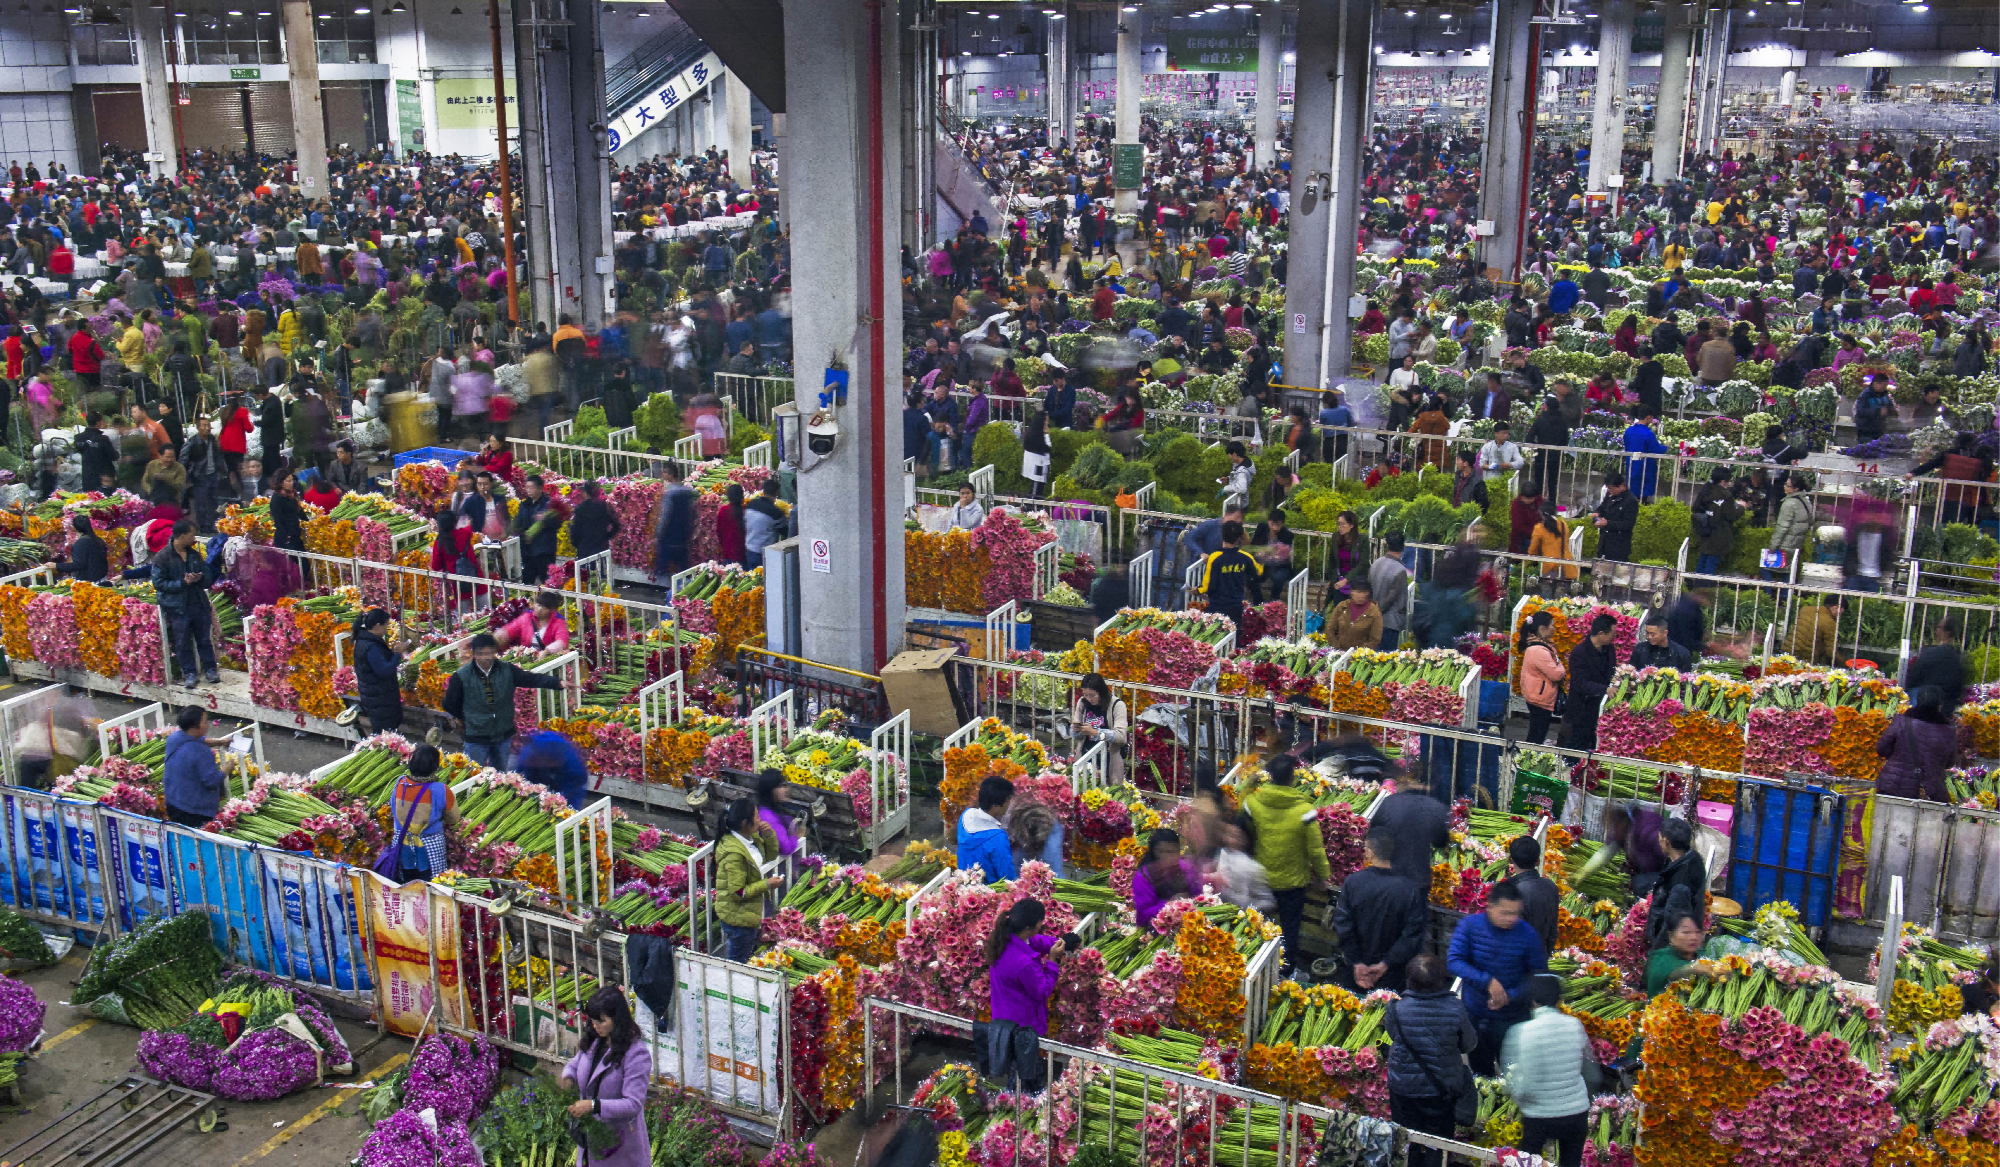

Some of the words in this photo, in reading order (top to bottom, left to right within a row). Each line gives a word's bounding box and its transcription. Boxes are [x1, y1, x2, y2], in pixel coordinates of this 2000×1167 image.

[446, 95, 484, 105] 由此上二楼
[635, 60, 725, 128] 大型多
[1857, 462, 1880, 474] 14
[206, 693, 219, 710] 3
[294, 713, 307, 729] 4
